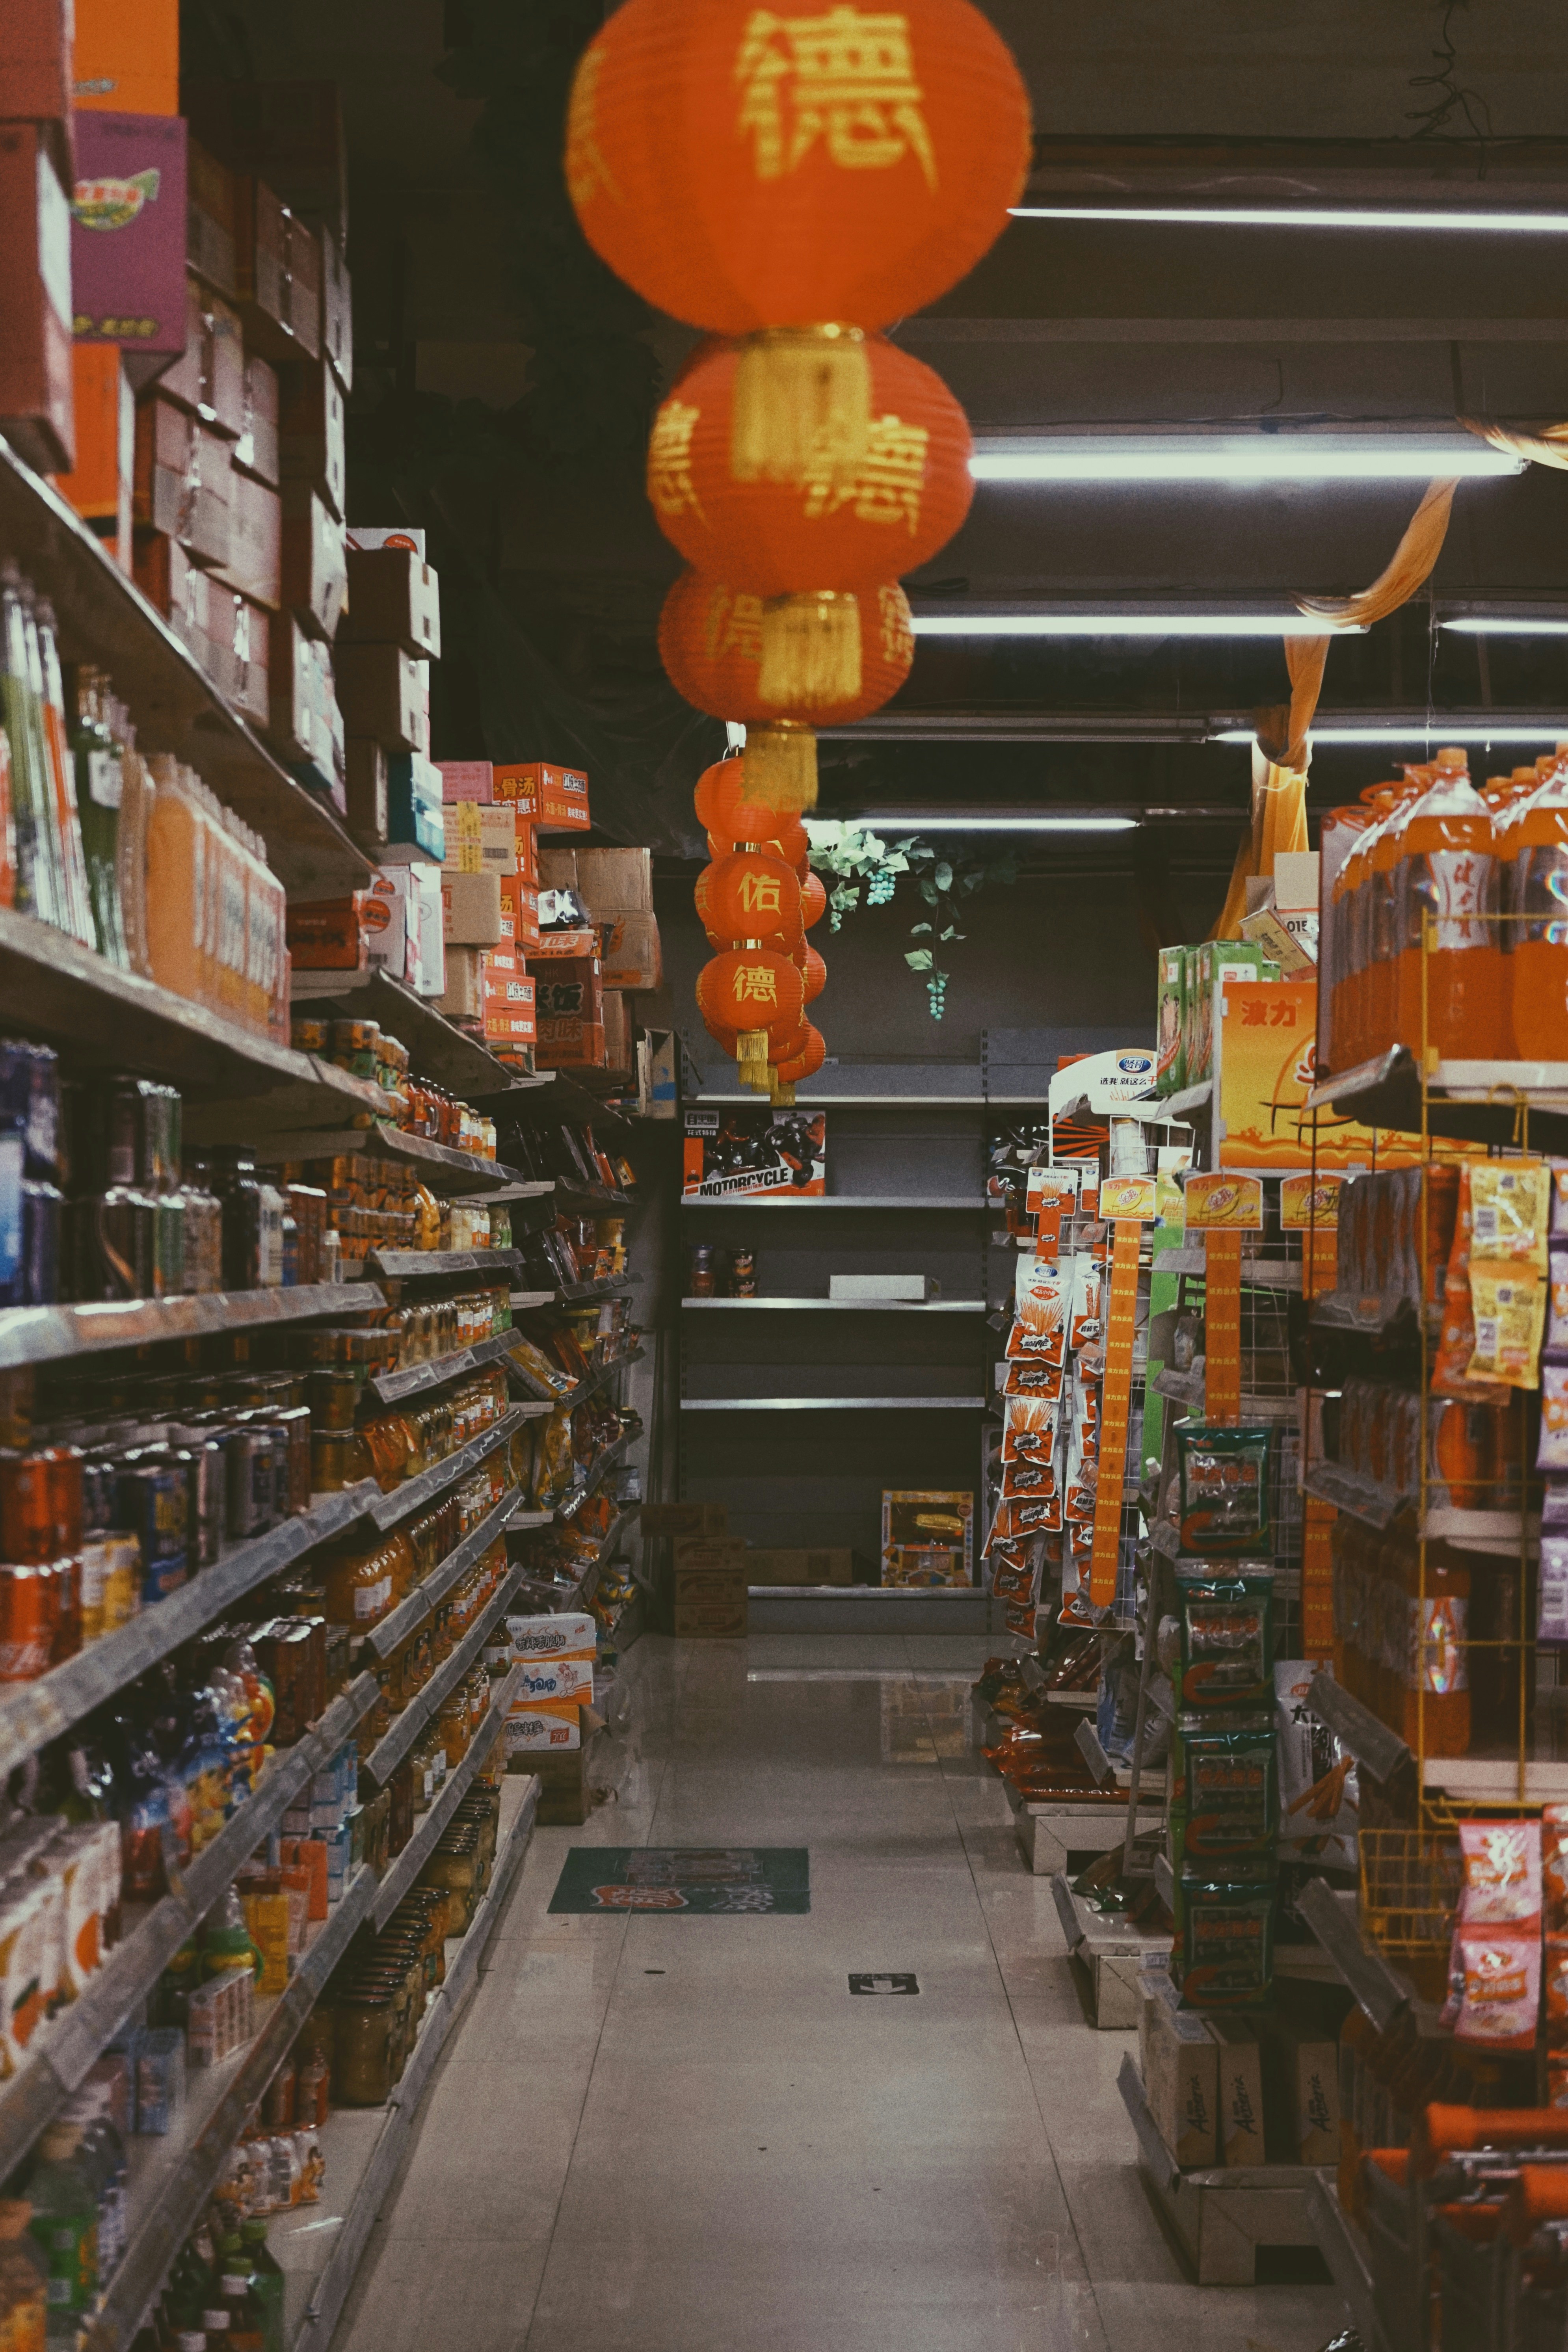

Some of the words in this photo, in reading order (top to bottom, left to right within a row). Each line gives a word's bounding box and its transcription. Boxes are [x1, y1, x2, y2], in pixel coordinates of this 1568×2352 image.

[733, 5, 939, 195] 德
[737, 872, 782, 915] 佑
[731, 965, 778, 1008] 德
[1241, 1000, 1296, 1027] 波力
[1124, 1060, 1145, 1069] 贤哥
[700, 1168, 789, 1196] MOTORCYCLE
[515, 1635, 566, 1651] 香辣香脆肠
[553, 1732, 566, 1742] 双汇
